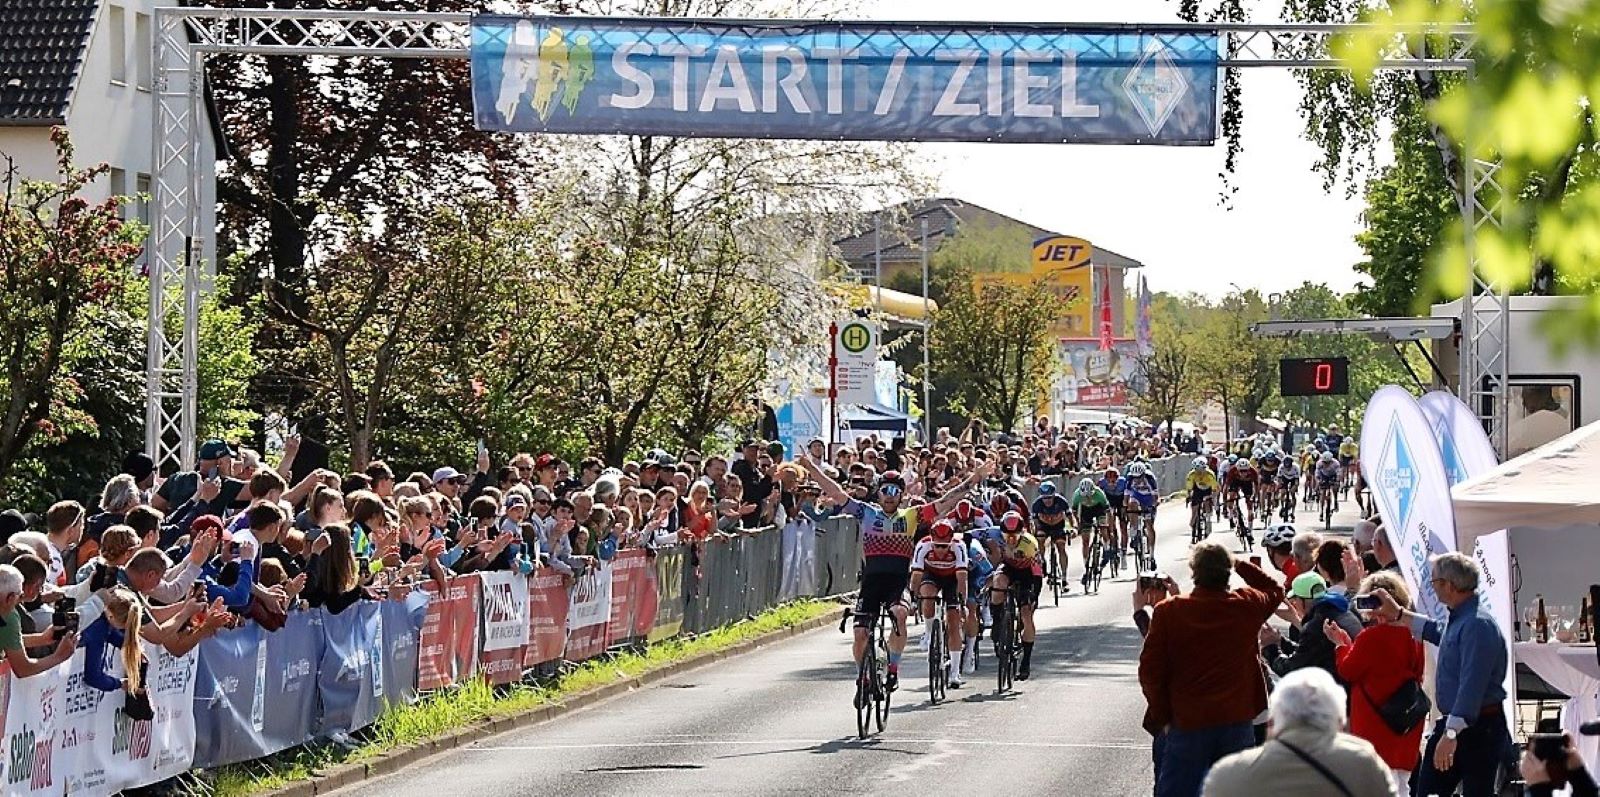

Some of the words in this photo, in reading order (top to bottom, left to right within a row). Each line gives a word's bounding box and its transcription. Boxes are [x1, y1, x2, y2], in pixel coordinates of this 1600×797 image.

[610, 41, 859, 114] START
[874, 48, 910, 115] /
[932, 48, 1100, 117] ZIEL
[1039, 244, 1083, 261] JET
[849, 329, 862, 346] H
[1315, 364, 1331, 389] 0
